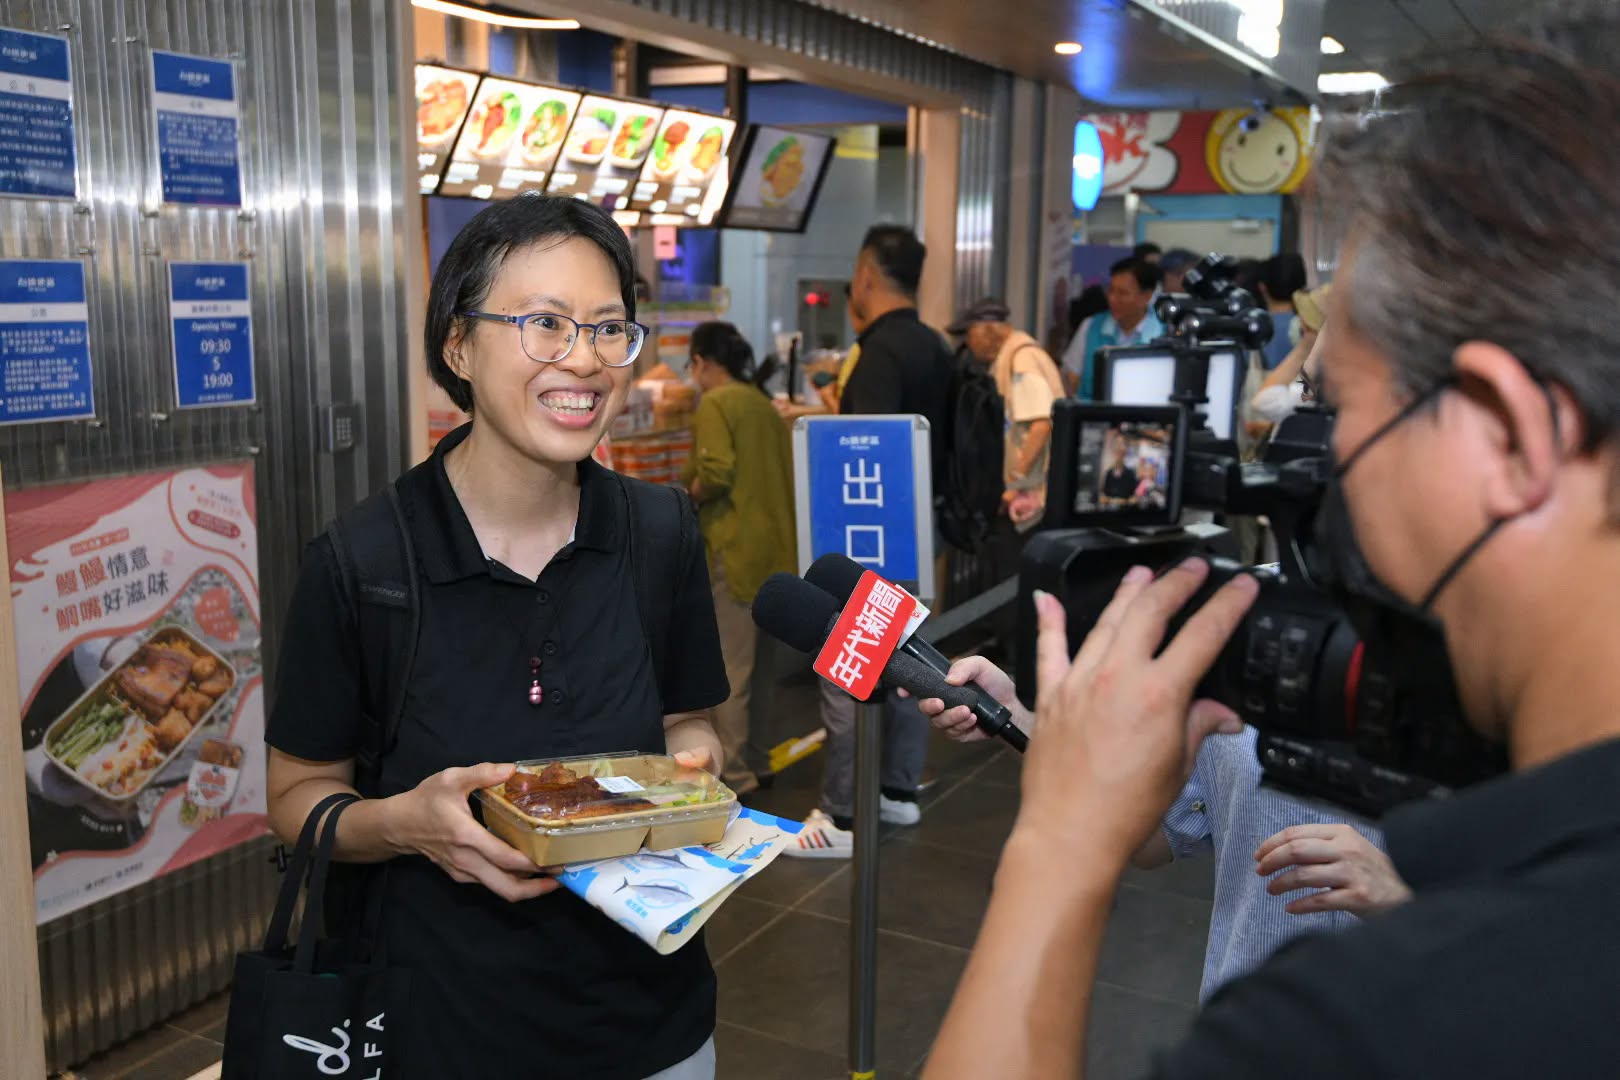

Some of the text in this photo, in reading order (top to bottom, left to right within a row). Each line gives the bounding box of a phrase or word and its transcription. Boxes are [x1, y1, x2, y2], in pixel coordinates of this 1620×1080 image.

[201, 338, 232, 354] 09:30
[203, 372, 233, 388] 19:00
[842, 458, 885, 568] 出口
[828, 579, 905, 689] 年代新聞
